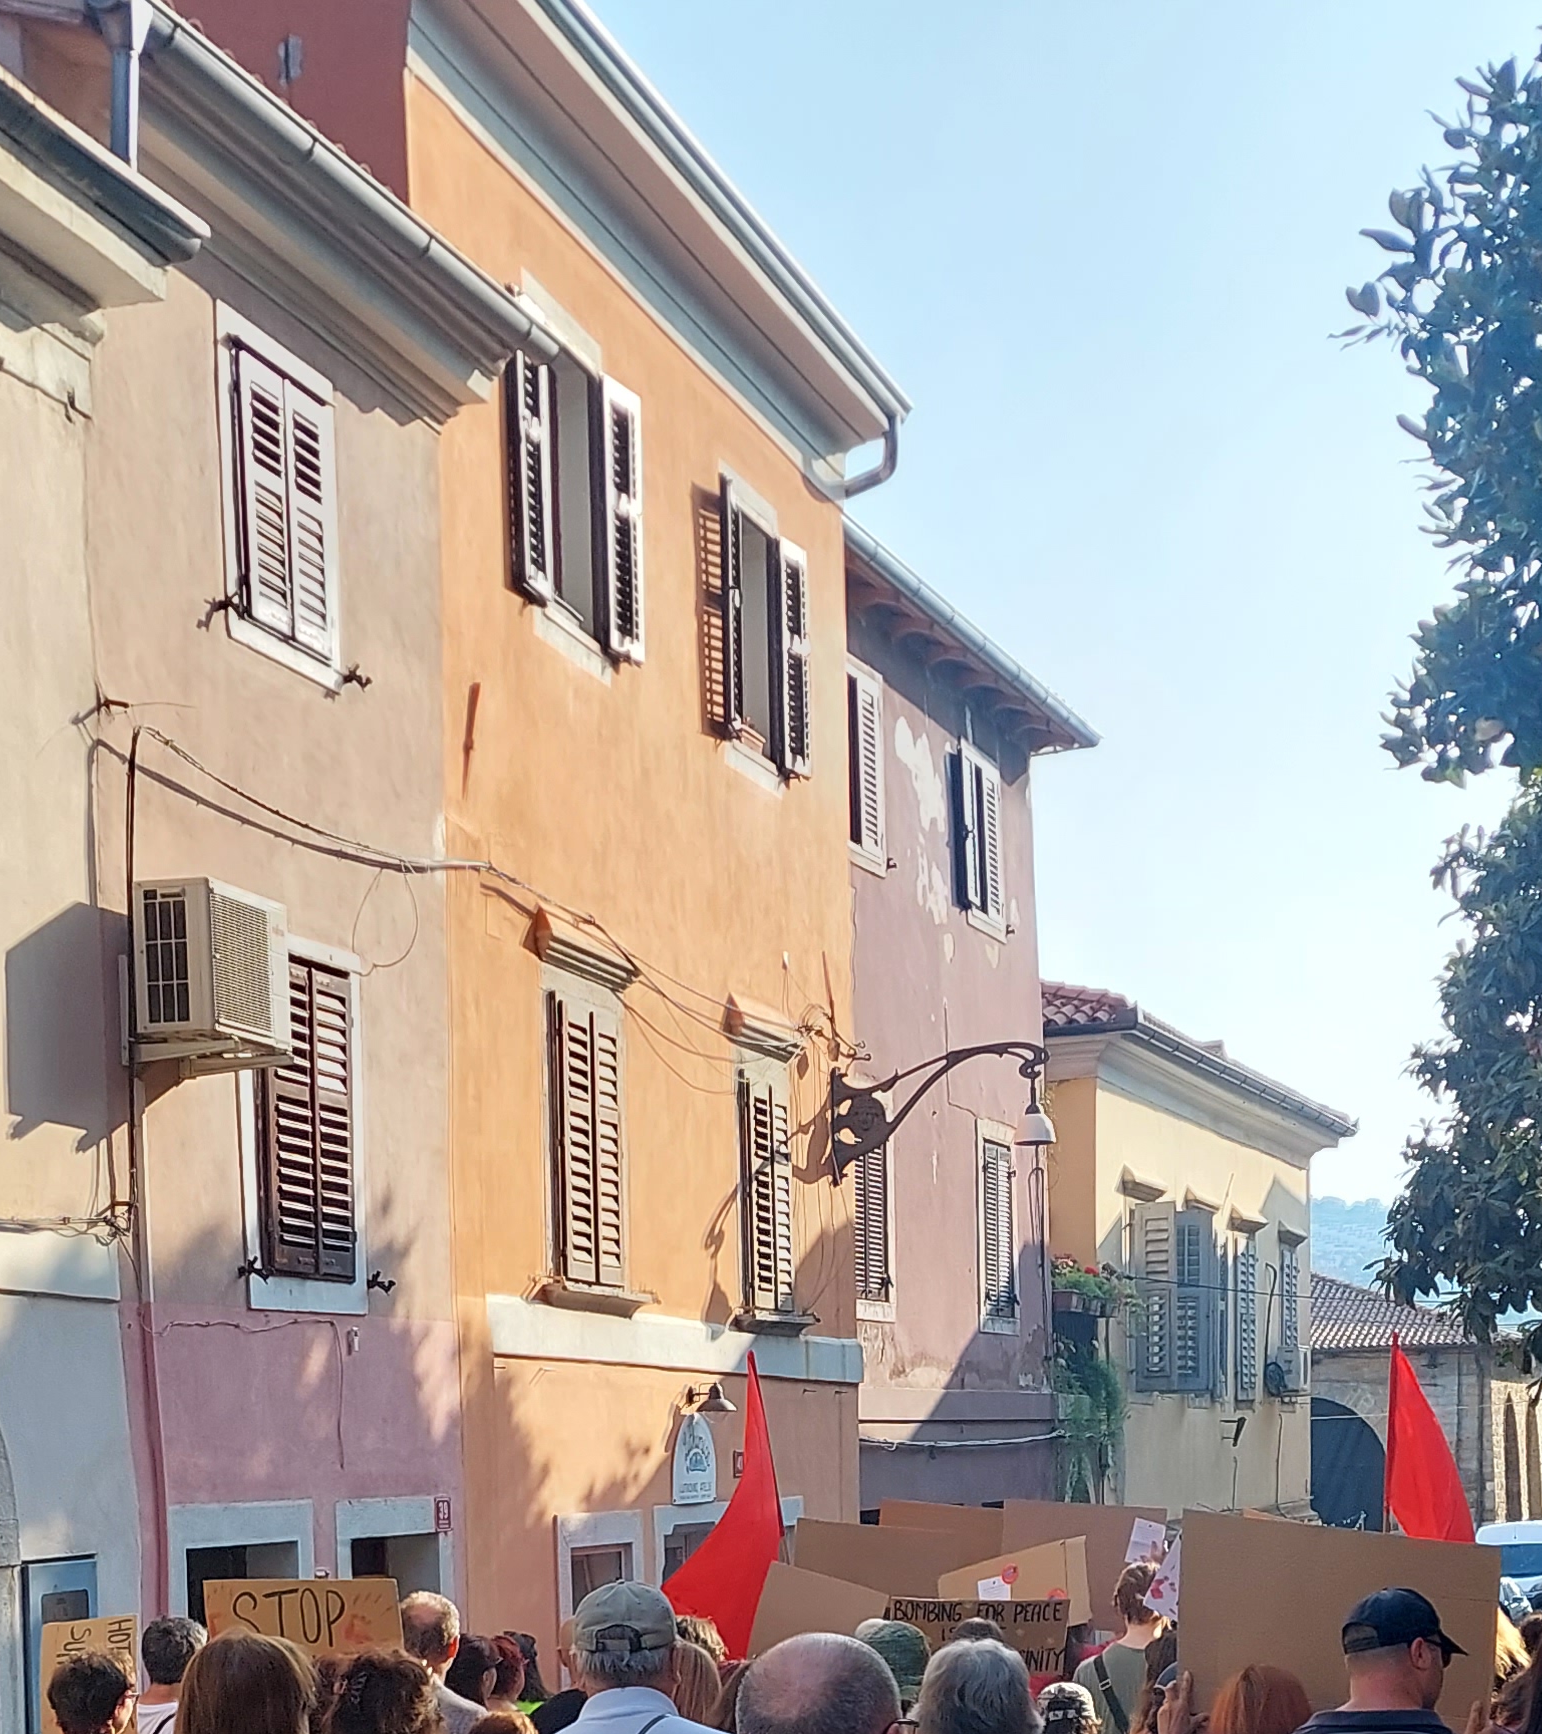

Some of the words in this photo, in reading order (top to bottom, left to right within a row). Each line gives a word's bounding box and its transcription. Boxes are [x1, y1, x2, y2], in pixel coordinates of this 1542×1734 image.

[232, 1587, 345, 1647] STOP
[893, 1601, 962, 1622] BOMBING
[977, 1603, 1005, 1621] FOR
[1014, 1602, 1062, 1622] PEACE
